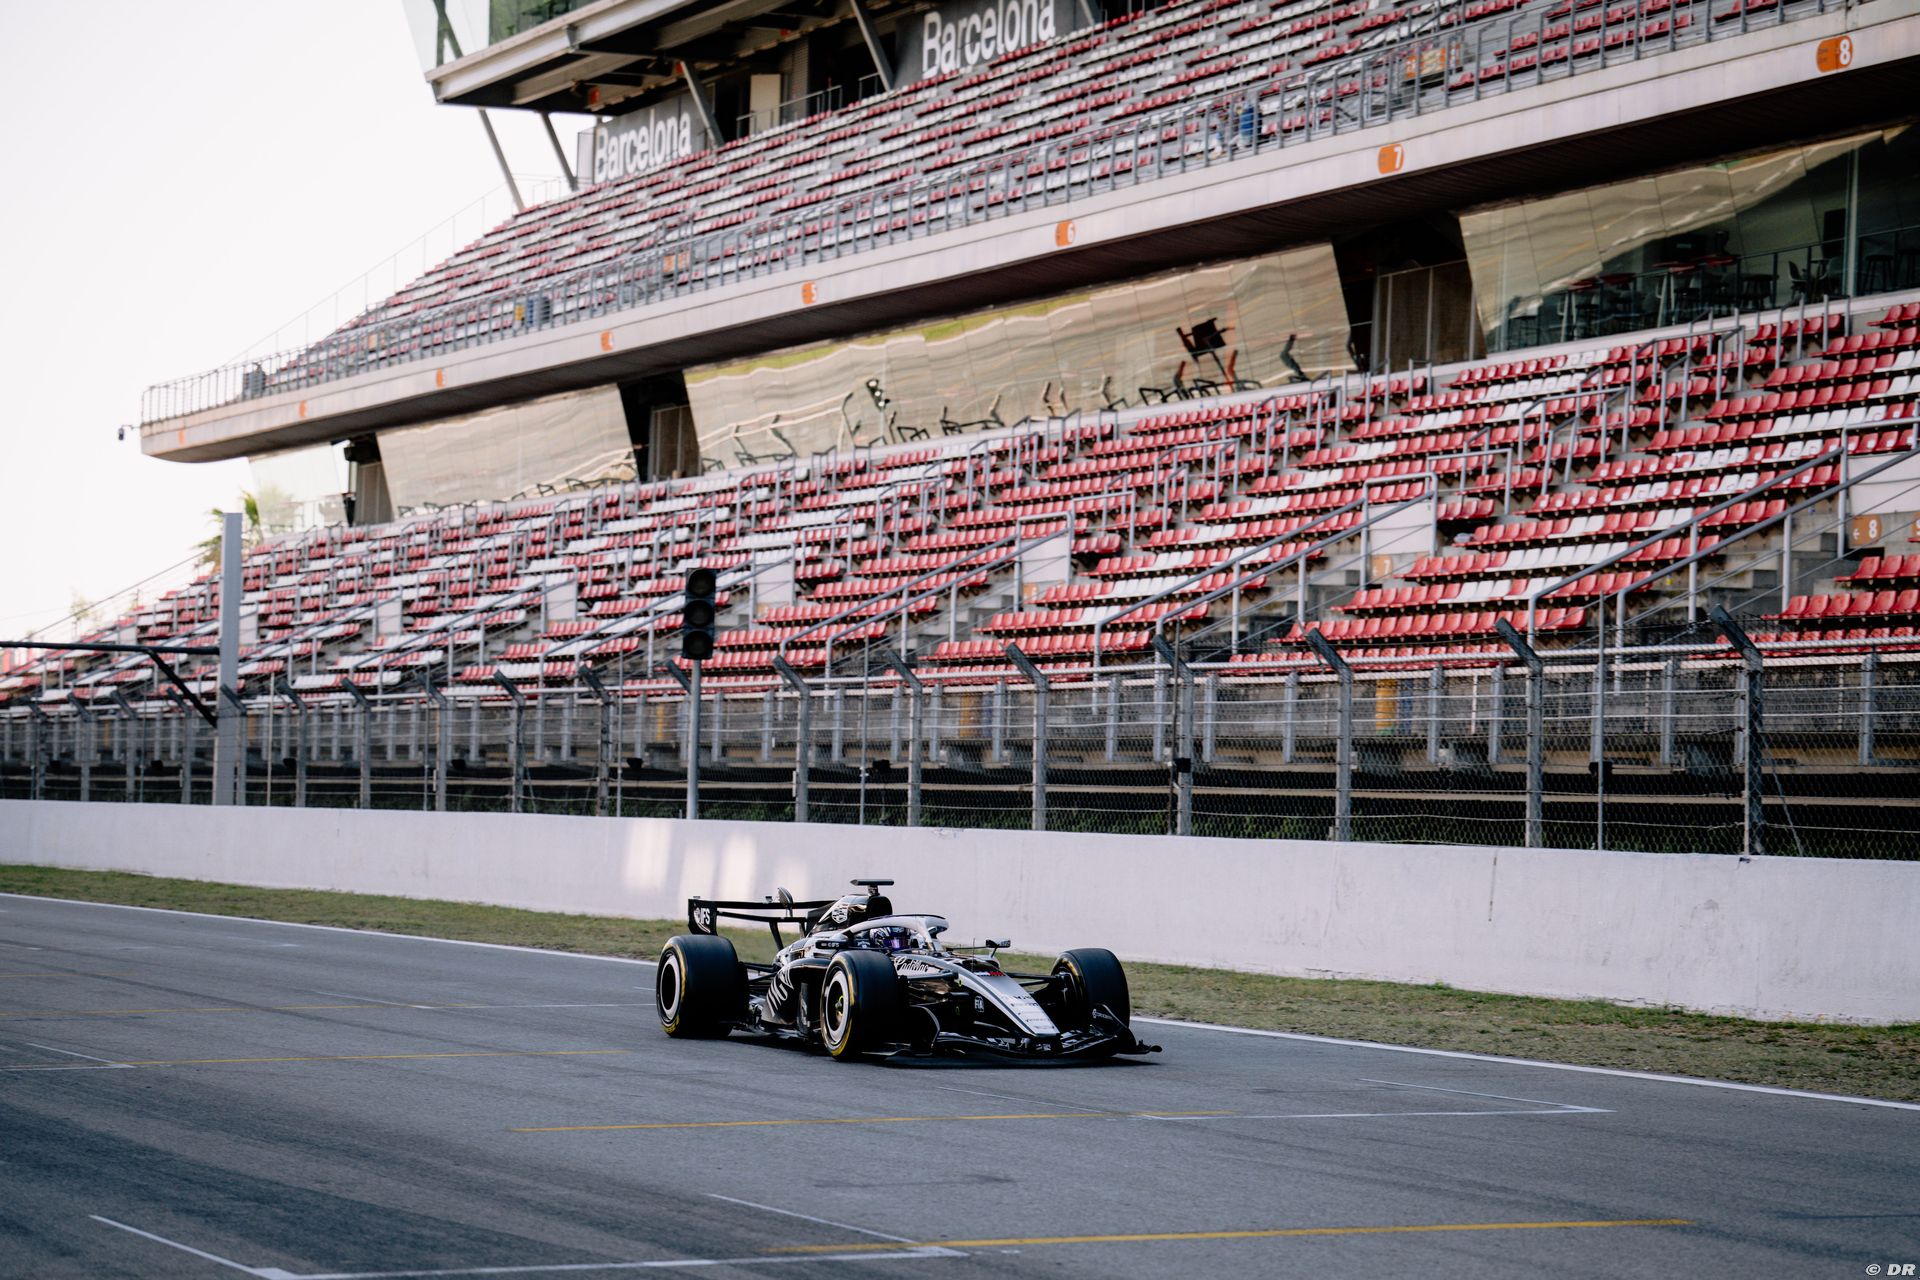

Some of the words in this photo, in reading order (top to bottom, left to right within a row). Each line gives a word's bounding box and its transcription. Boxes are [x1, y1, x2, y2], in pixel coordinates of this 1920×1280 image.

[922, 0, 1055, 80] Barcelona
[1839, 39, 1851, 66] 8
[594, 108, 691, 183] Barcelona
[1394, 146, 1402, 169] 7
[1067, 221, 1075, 244] 6
[1868, 519, 1878, 539] 8
[894, 955, 929, 972] Cadillac
